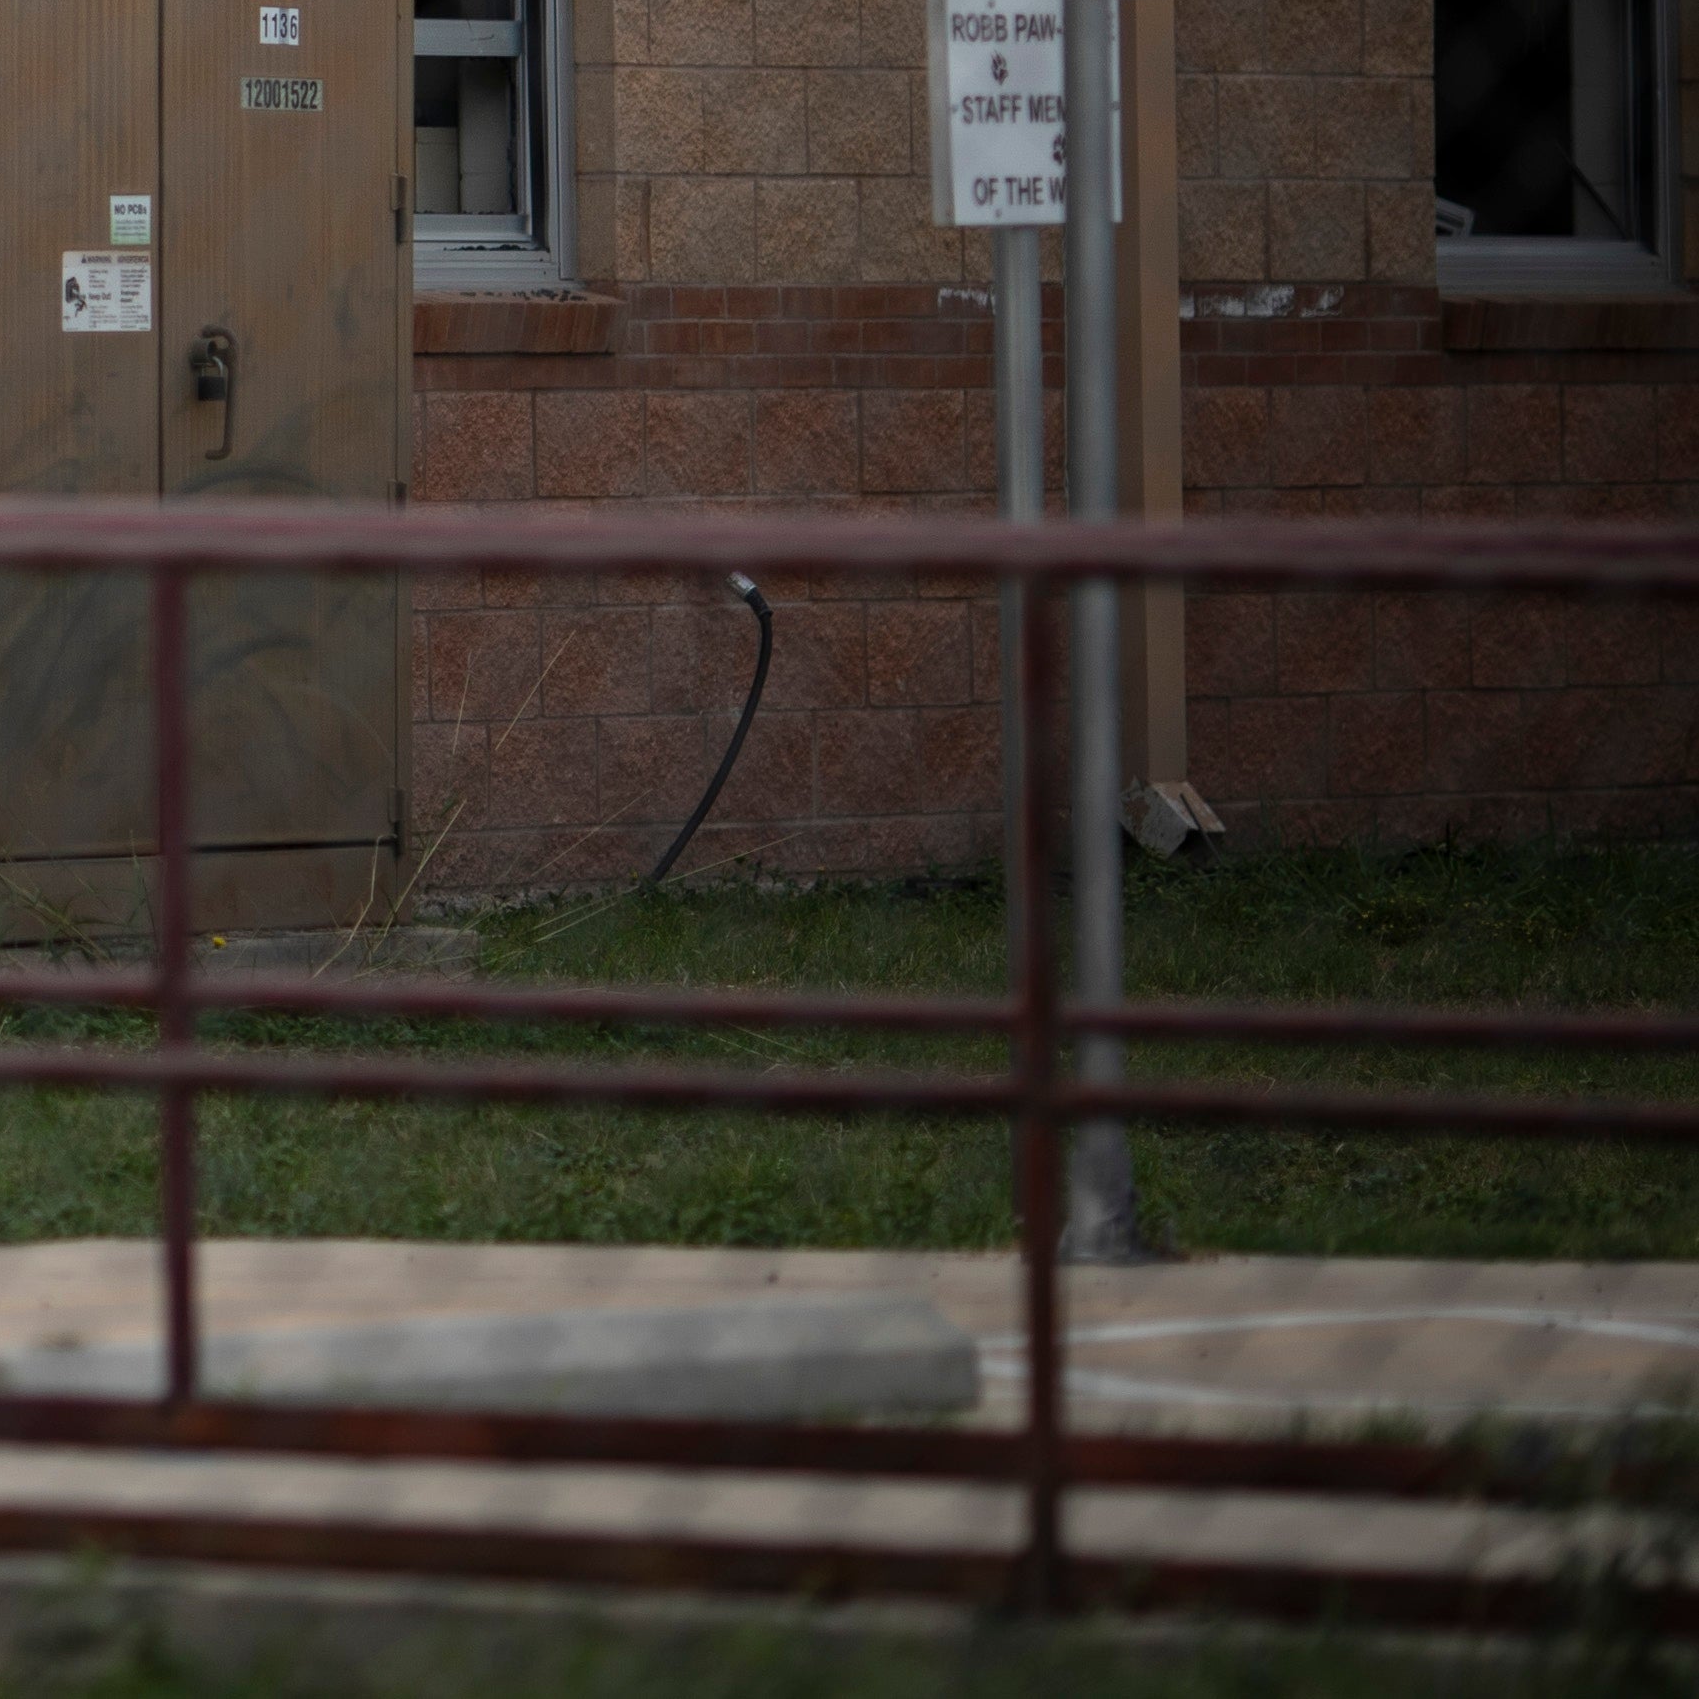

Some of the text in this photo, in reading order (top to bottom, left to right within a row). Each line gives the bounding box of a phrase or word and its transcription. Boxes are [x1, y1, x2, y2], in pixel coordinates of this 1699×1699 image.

[262, 12, 298, 40] 1136
[952, 13, 1009, 43] ROBB
[245, 79, 318, 110] 12001522
[961, 94, 1022, 125] STAFF
[973, 176, 999, 206] OF
[1005, 176, 1043, 205] THE
[114, 203, 147, 215] NO PCBs
